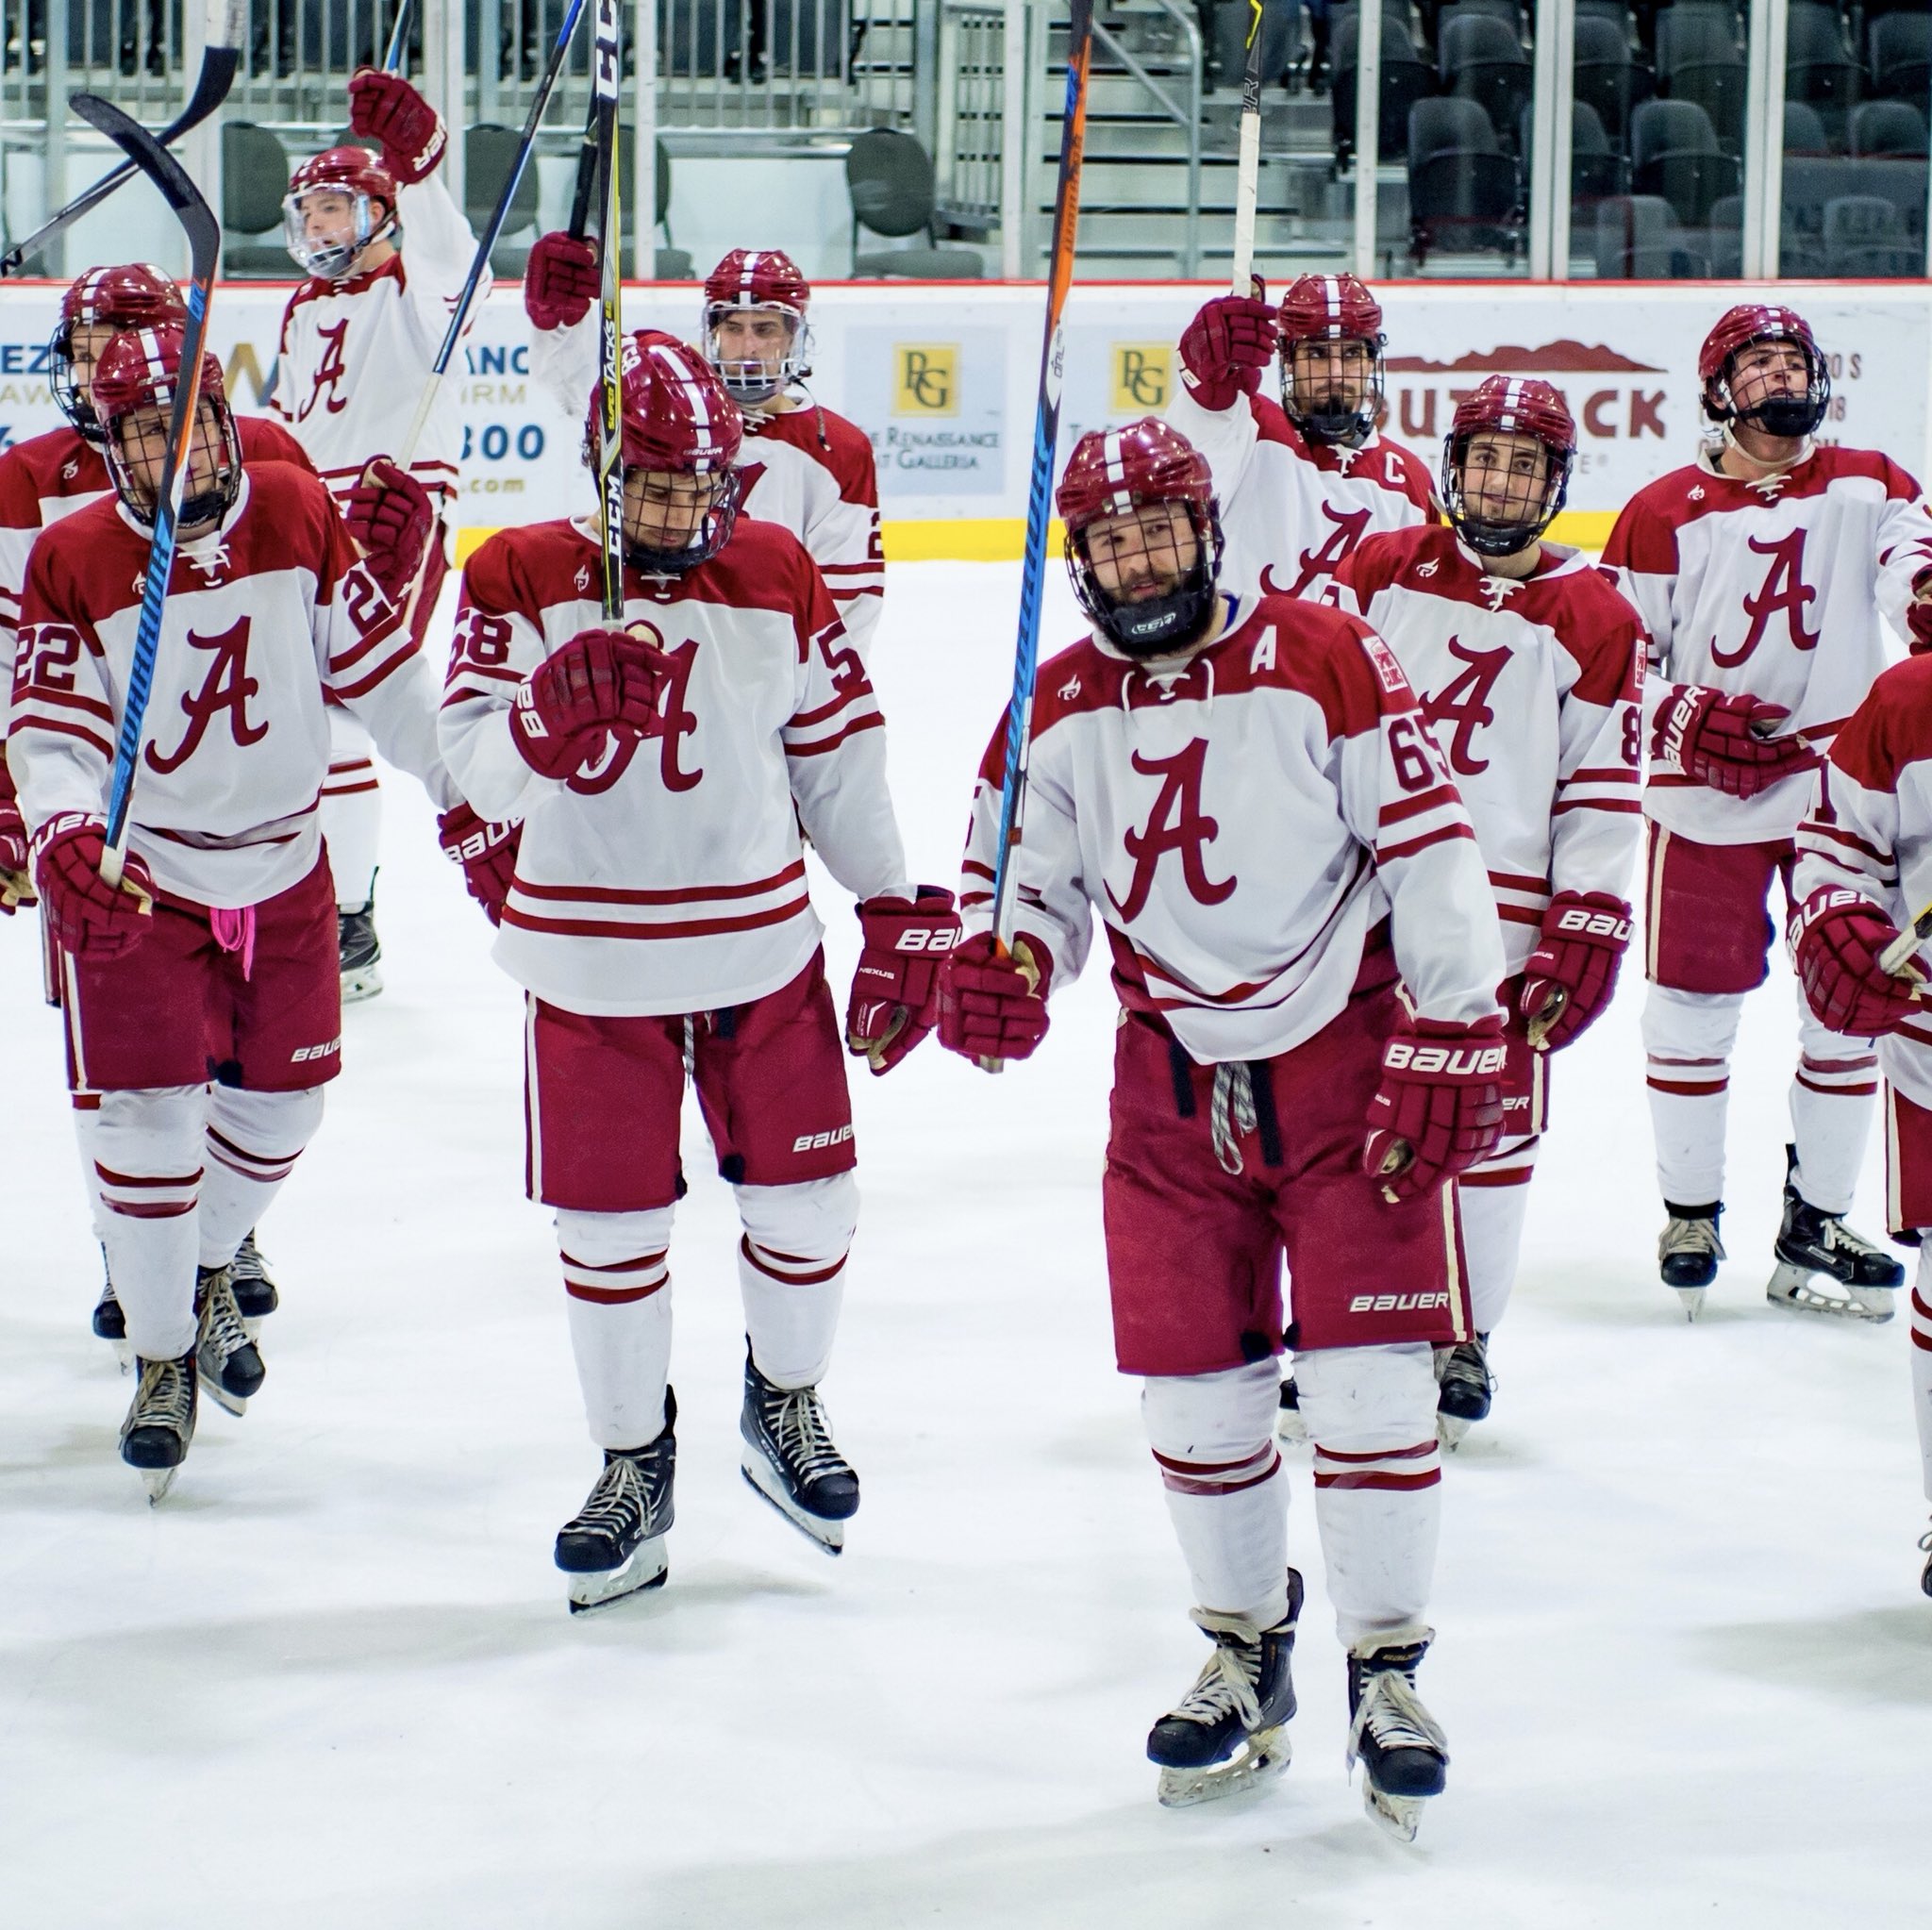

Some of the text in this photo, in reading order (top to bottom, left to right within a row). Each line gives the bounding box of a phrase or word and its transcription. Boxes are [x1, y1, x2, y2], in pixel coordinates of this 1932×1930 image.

[1385, 451, 1407, 484] C
[608, 474, 623, 557] CCM
[12, 624, 81, 693] 22
[1250, 624, 1277, 675] A
